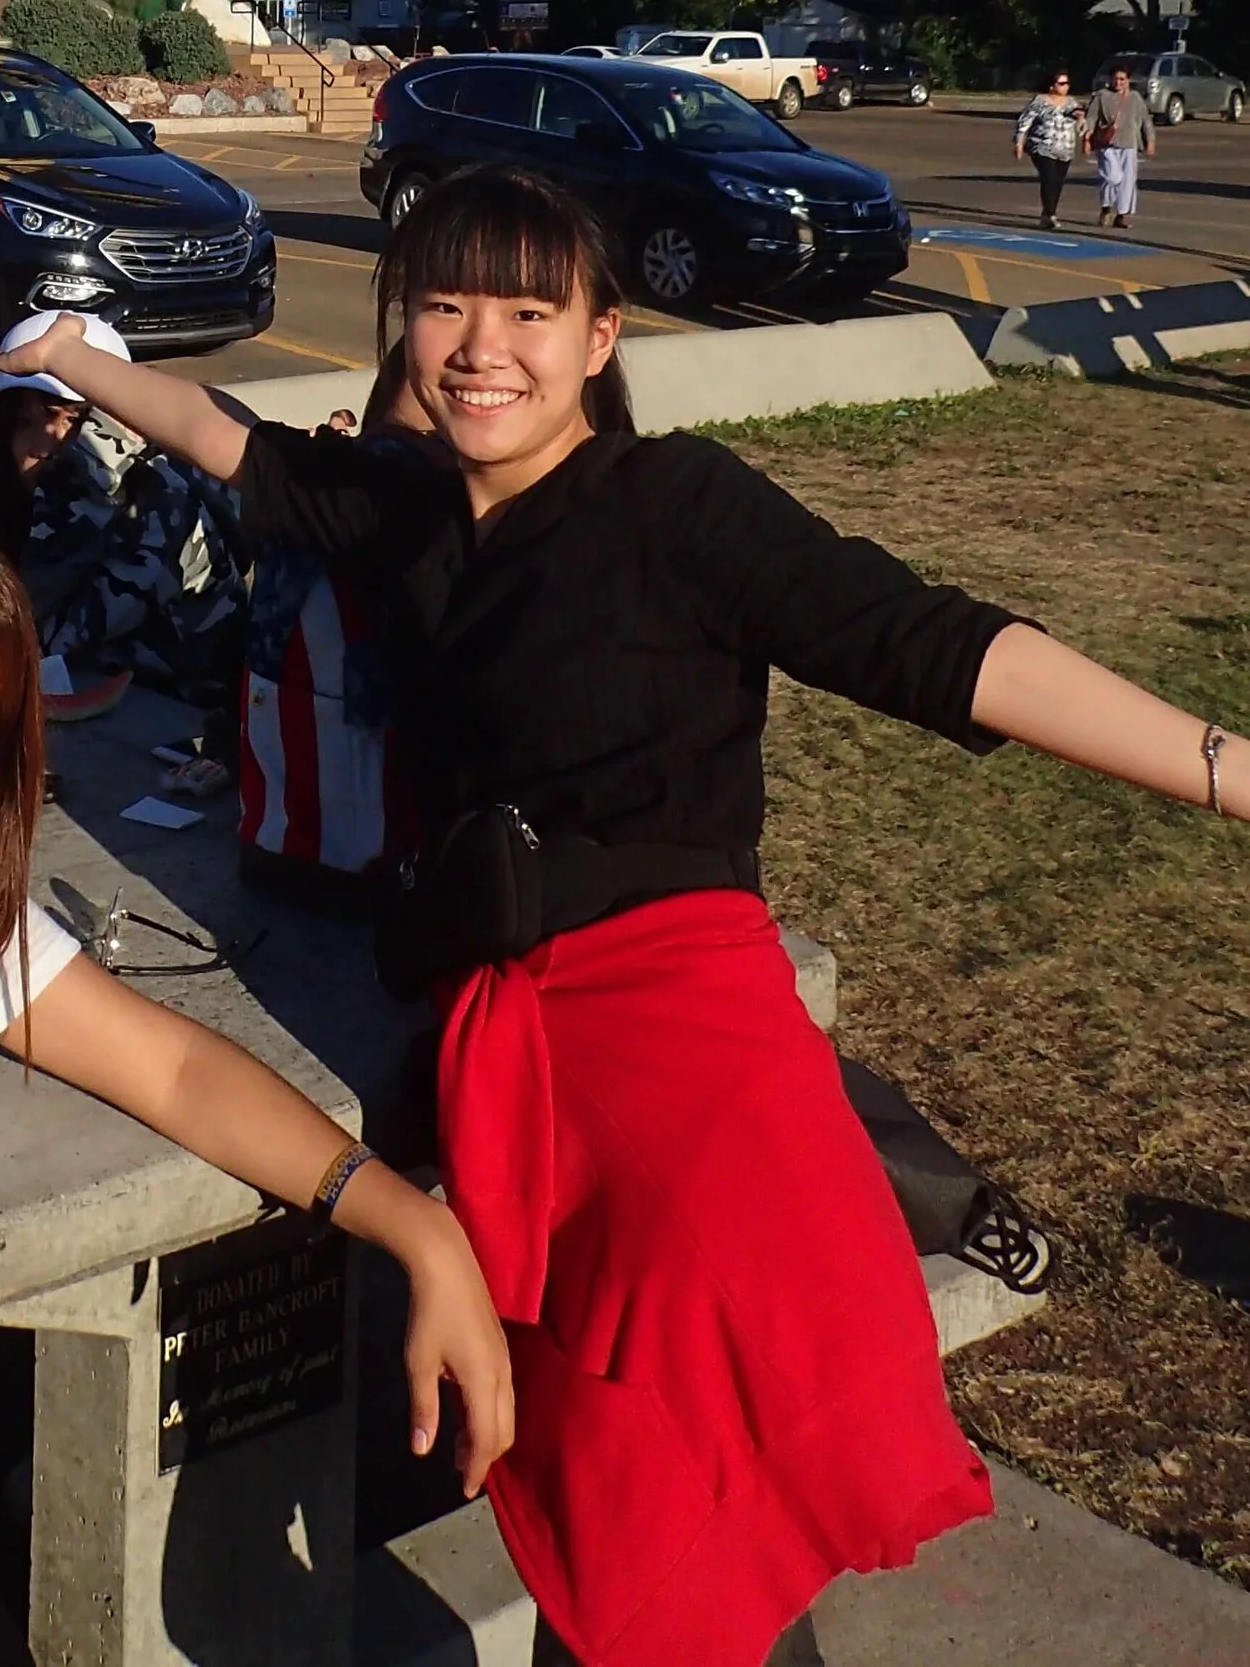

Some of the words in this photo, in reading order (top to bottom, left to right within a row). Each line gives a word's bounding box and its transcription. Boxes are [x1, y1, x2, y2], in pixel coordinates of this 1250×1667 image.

[290, 1249, 314, 1282] BY
[161, 1317, 228, 1364] PETER
[238, 1275, 342, 1335] BANCROFT
[214, 1321, 292, 1374] FAMILY
